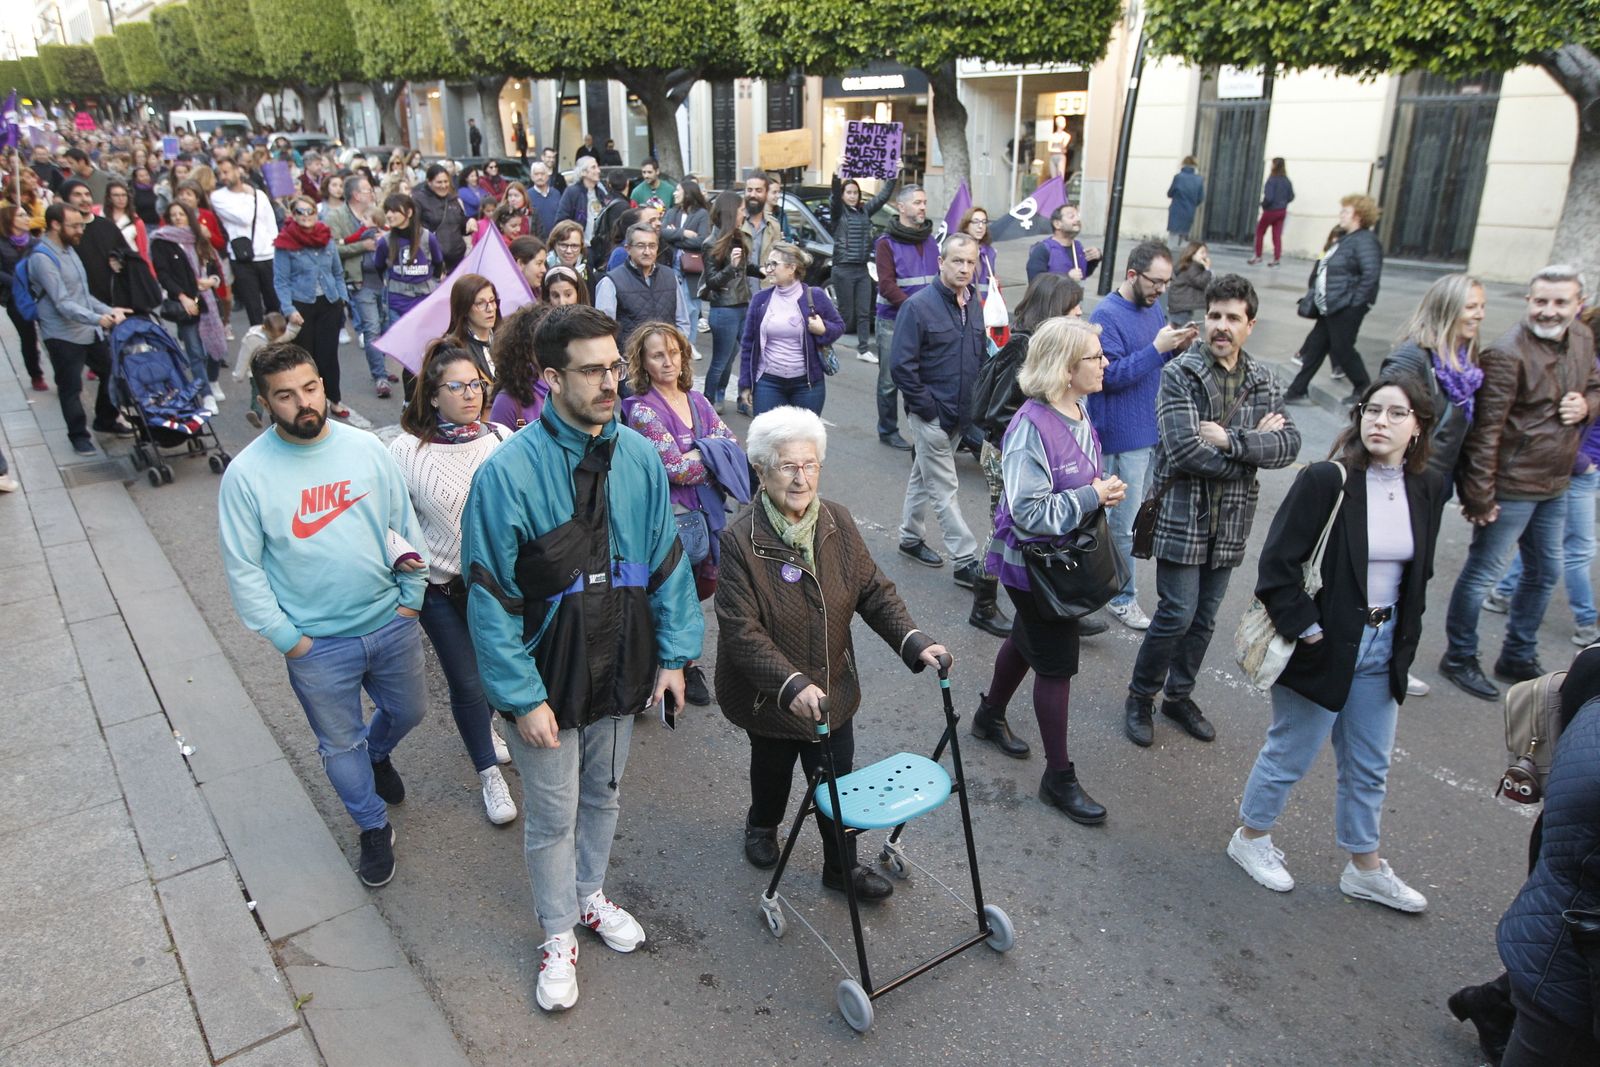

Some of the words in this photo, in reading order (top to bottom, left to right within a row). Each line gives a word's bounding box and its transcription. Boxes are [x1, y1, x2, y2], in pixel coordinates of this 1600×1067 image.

[848, 121, 860, 134] EL
[846, 134, 872, 146] CADO
[873, 135, 887, 147] ES
[845, 146, 887, 160] MOLESTO
[300, 480, 351, 516] NIKE
